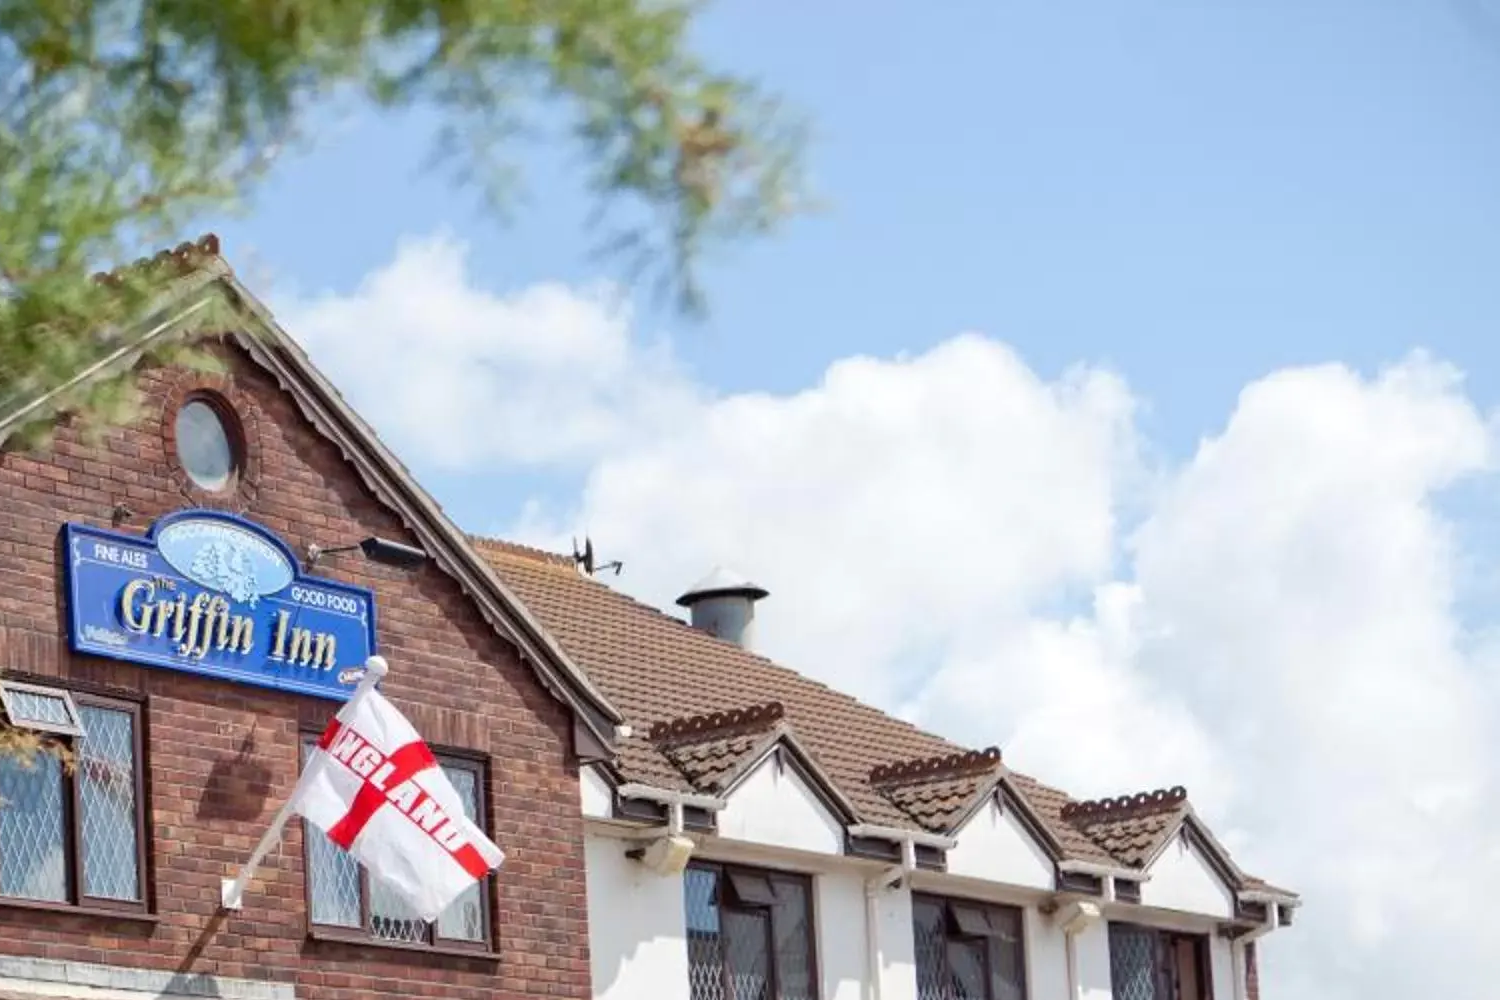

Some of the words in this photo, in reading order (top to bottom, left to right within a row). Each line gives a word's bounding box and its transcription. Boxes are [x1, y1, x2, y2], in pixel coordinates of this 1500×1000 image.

[94, 543, 120, 562] FINE
[121, 549, 148, 568] ALES
[120, 578, 255, 658] Griffin
[267, 608, 337, 671] Inn
[291, 586, 326, 606] GOOD
[327, 594, 357, 613] FOOD
[328, 724, 468, 852] NGLAND
